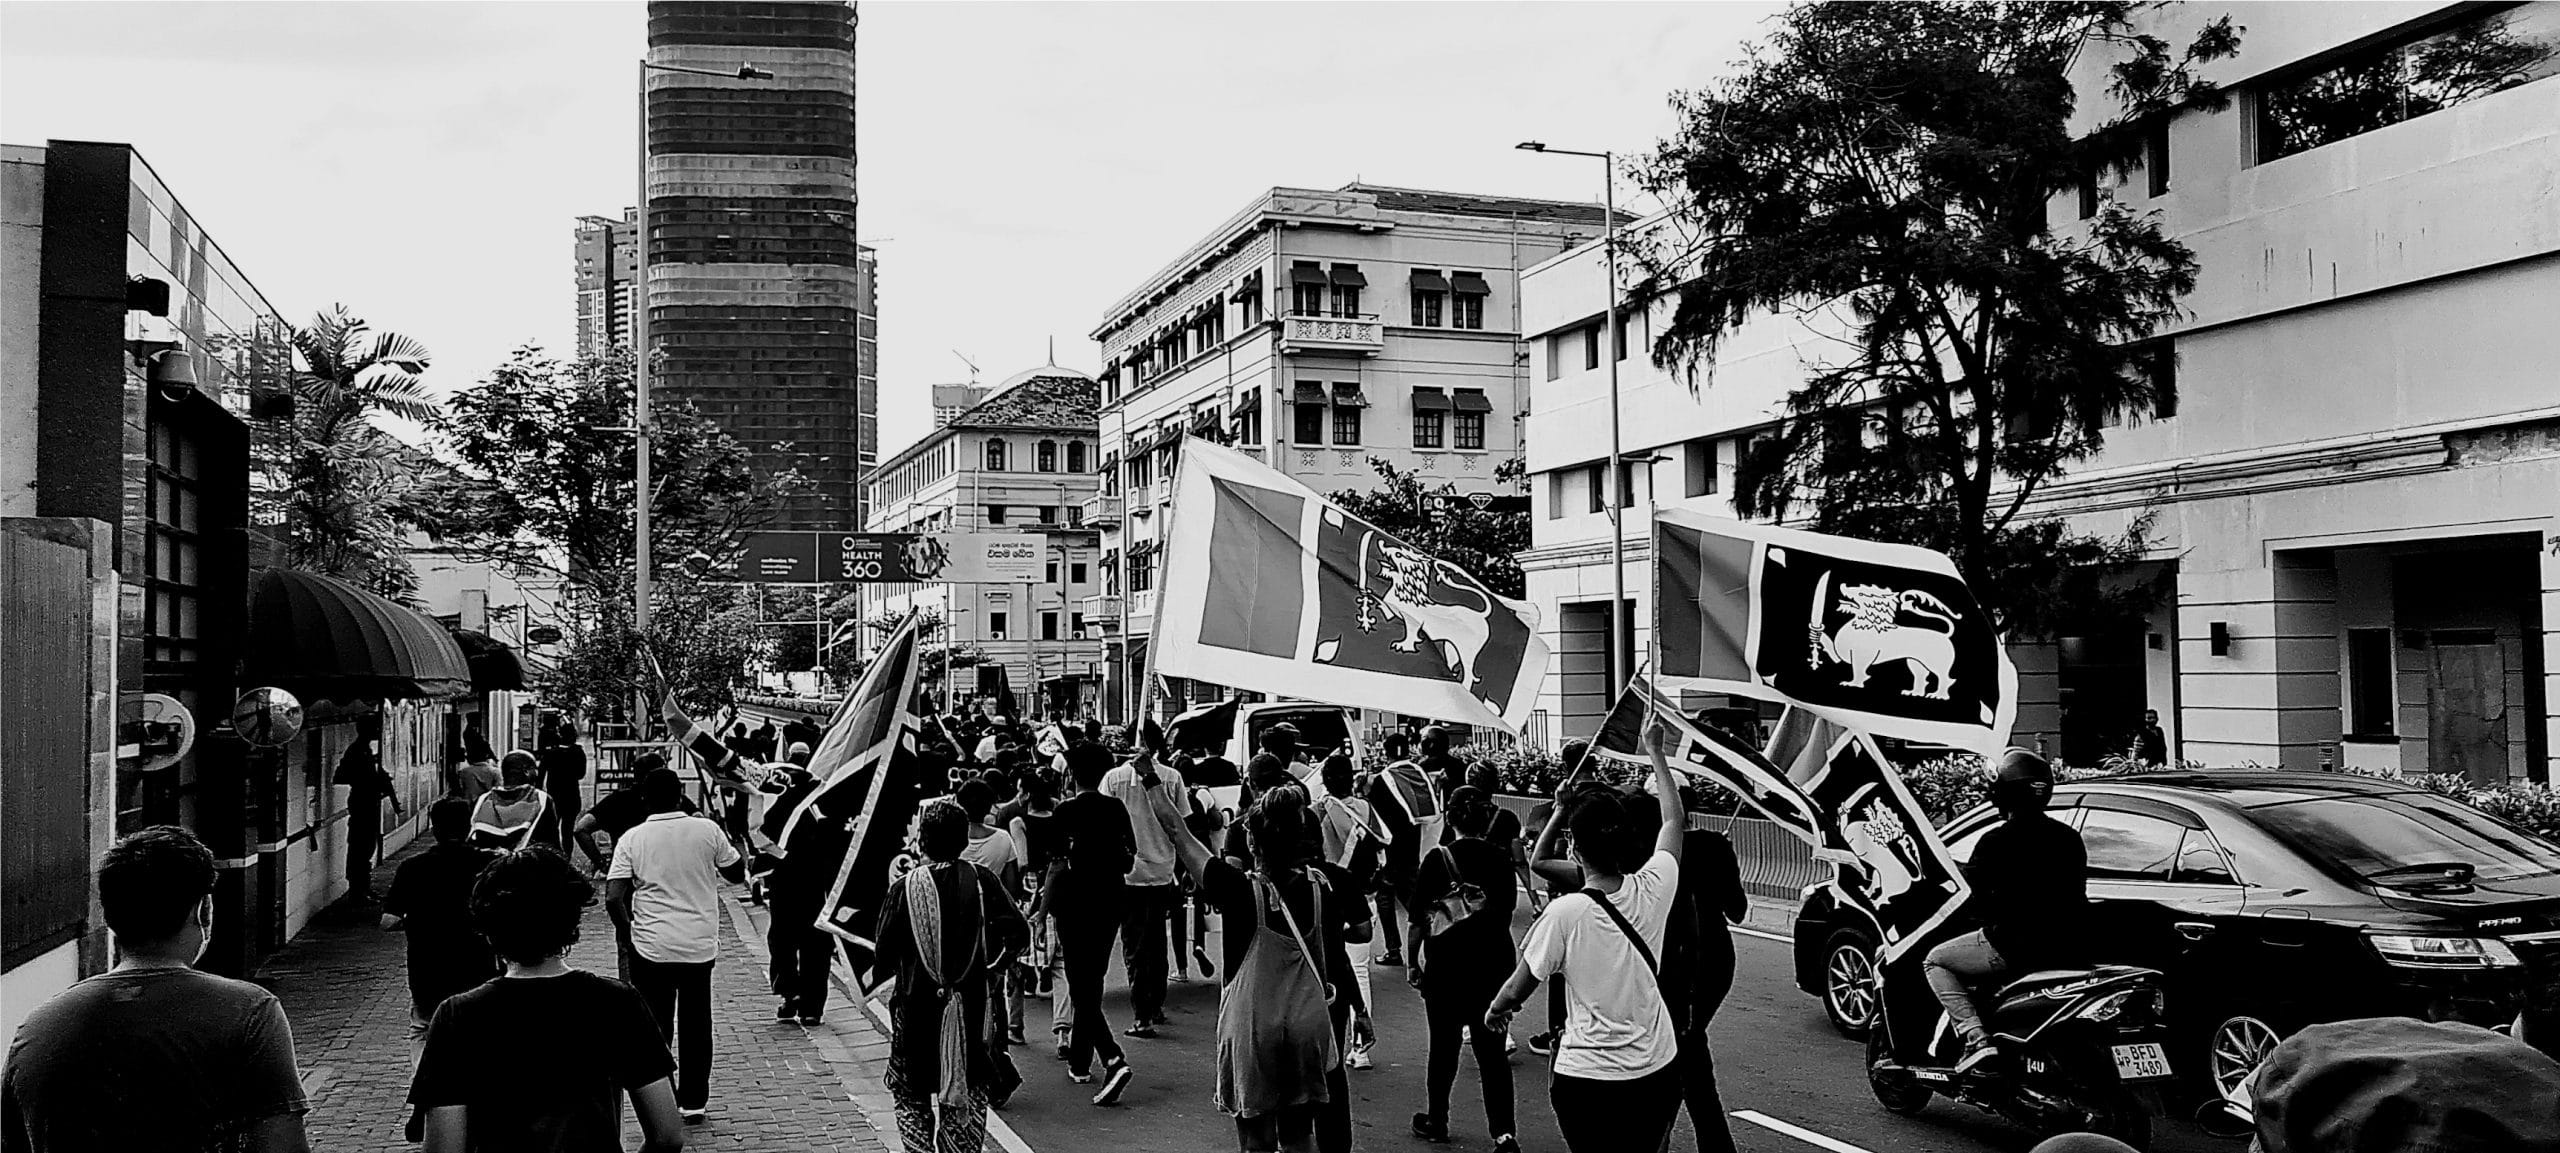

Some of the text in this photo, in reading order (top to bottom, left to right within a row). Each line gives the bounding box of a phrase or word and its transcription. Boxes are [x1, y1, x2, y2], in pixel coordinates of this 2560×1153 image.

[842, 551, 882, 560] HEALTH
[842, 561, 882, 578] 360
[2129, 1045, 2157, 1060] BFD
[2133, 1060, 2162, 1076] 3489
[1915, 1071, 1949, 1081] HONDA
